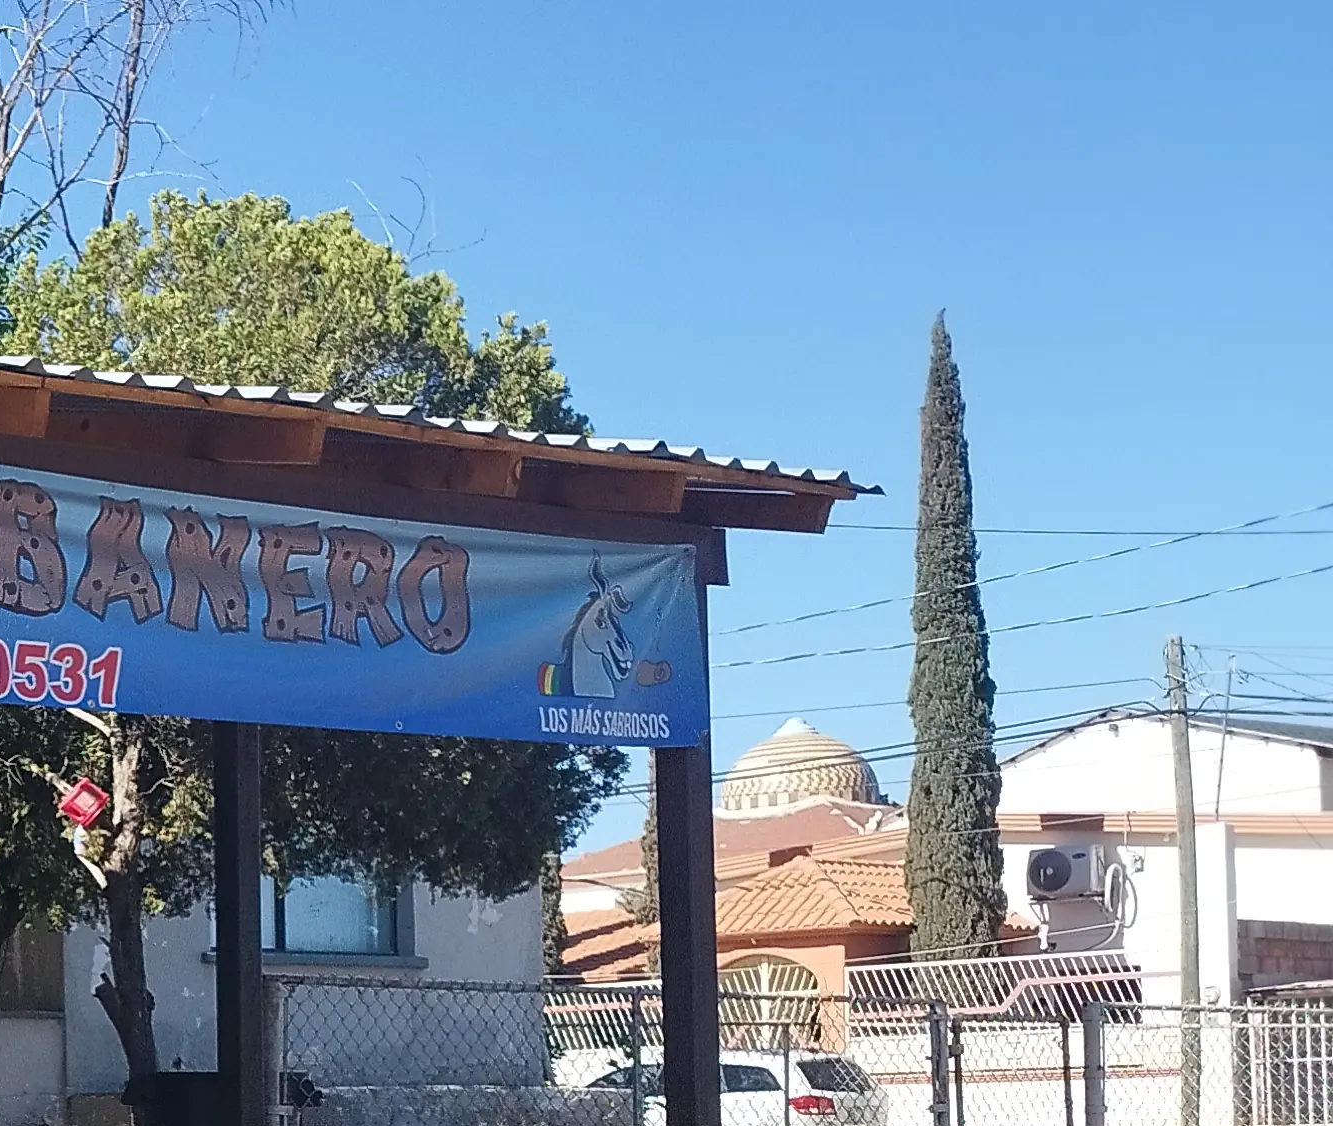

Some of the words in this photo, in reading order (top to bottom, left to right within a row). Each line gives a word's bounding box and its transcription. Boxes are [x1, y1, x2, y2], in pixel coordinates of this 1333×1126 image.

[538, 706, 568, 734] LOS
[570, 703, 602, 736] MÁS
[602, 711, 670, 739] SABROSOS
